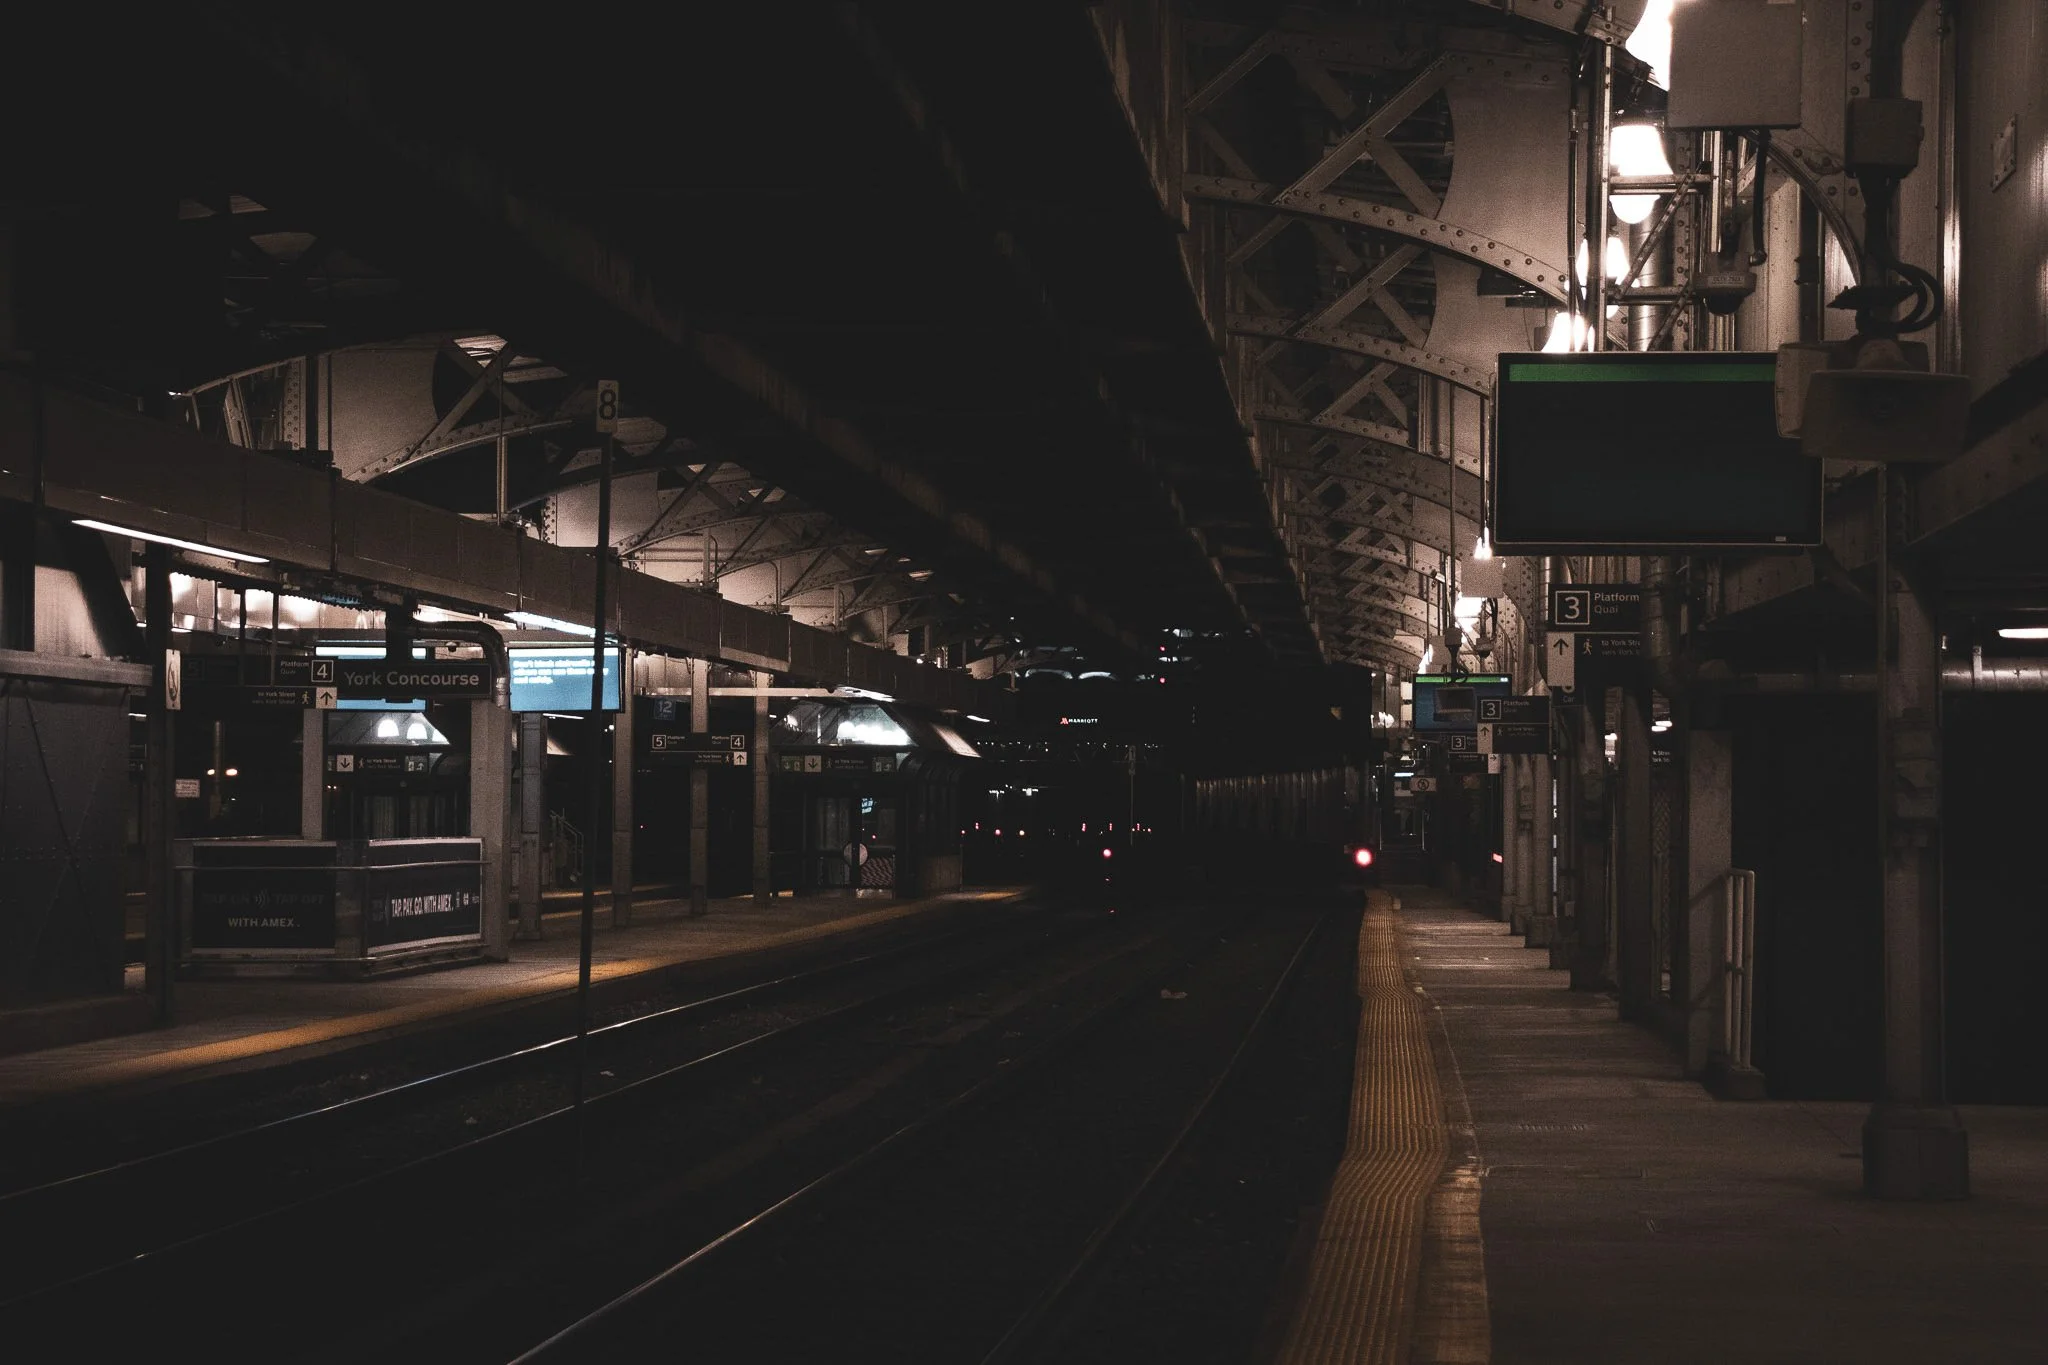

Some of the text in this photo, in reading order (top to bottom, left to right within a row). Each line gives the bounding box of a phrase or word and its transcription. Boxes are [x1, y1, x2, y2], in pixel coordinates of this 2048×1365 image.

[599, 389, 616, 420] 8
[1594, 592, 1640, 602] Platform
[1564, 596, 1580, 619] 3
[1594, 604, 1619, 615] Quai
[280, 660, 310, 668] Platform
[316, 663, 328, 679] 4
[344, 671, 480, 686] York Concourse
[659, 701, 672, 713] 12
[1486, 702, 1496, 716] 3
[655, 737, 663, 747] 5
[733, 737, 742, 747] 4
[1455, 738, 1462, 748] 3
[424, 894, 437, 914] WITH
[228, 917, 258, 927] WITH
